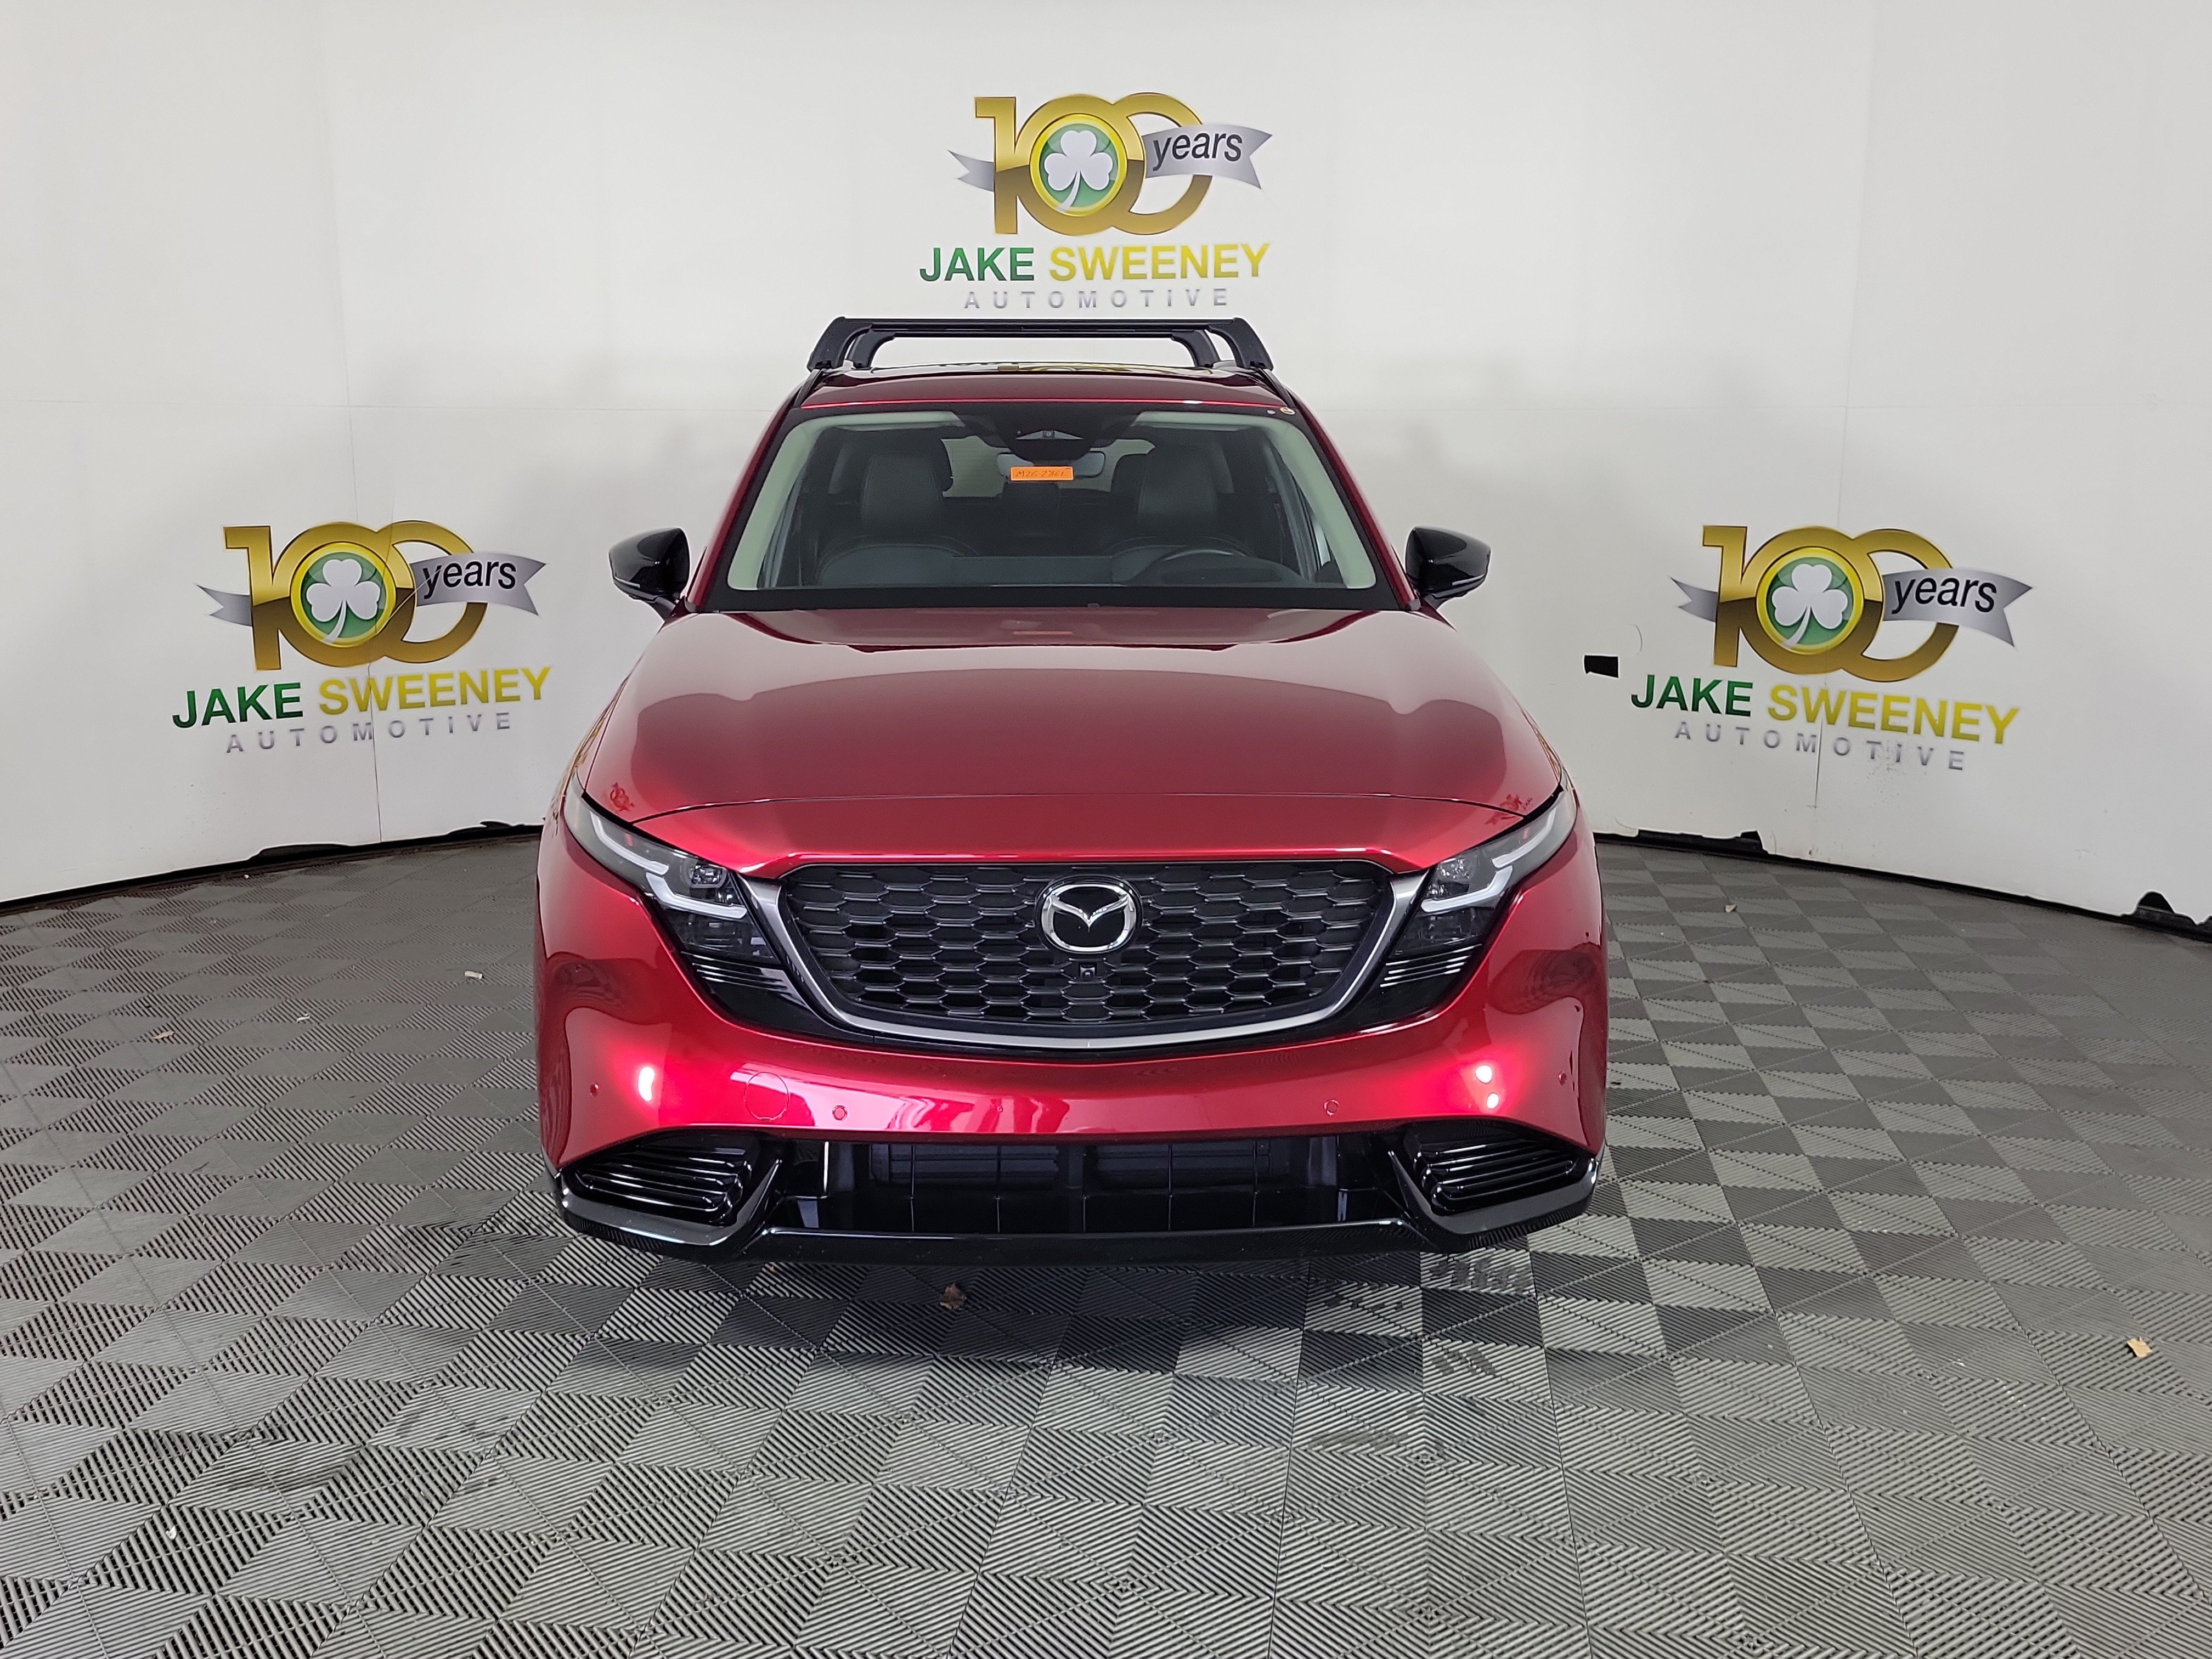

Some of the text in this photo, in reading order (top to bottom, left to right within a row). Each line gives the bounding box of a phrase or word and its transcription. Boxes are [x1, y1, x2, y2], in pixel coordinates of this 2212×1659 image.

[974, 92, 1243, 236] 100 years
[919, 242, 1270, 282] JAKE SWEENEY
[963, 288, 1227, 309] AUTOMOTIVE
[222, 520, 517, 672] 100 years
[1702, 524, 1998, 682] 100 years
[172, 667, 551, 729] JAKE SWEENEY
[1630, 674, 2020, 745] JAKE SWEENEY
[225, 712, 511, 754] AUTOMOTIVE
[1674, 721, 1965, 771] AUTOMOTIVE
